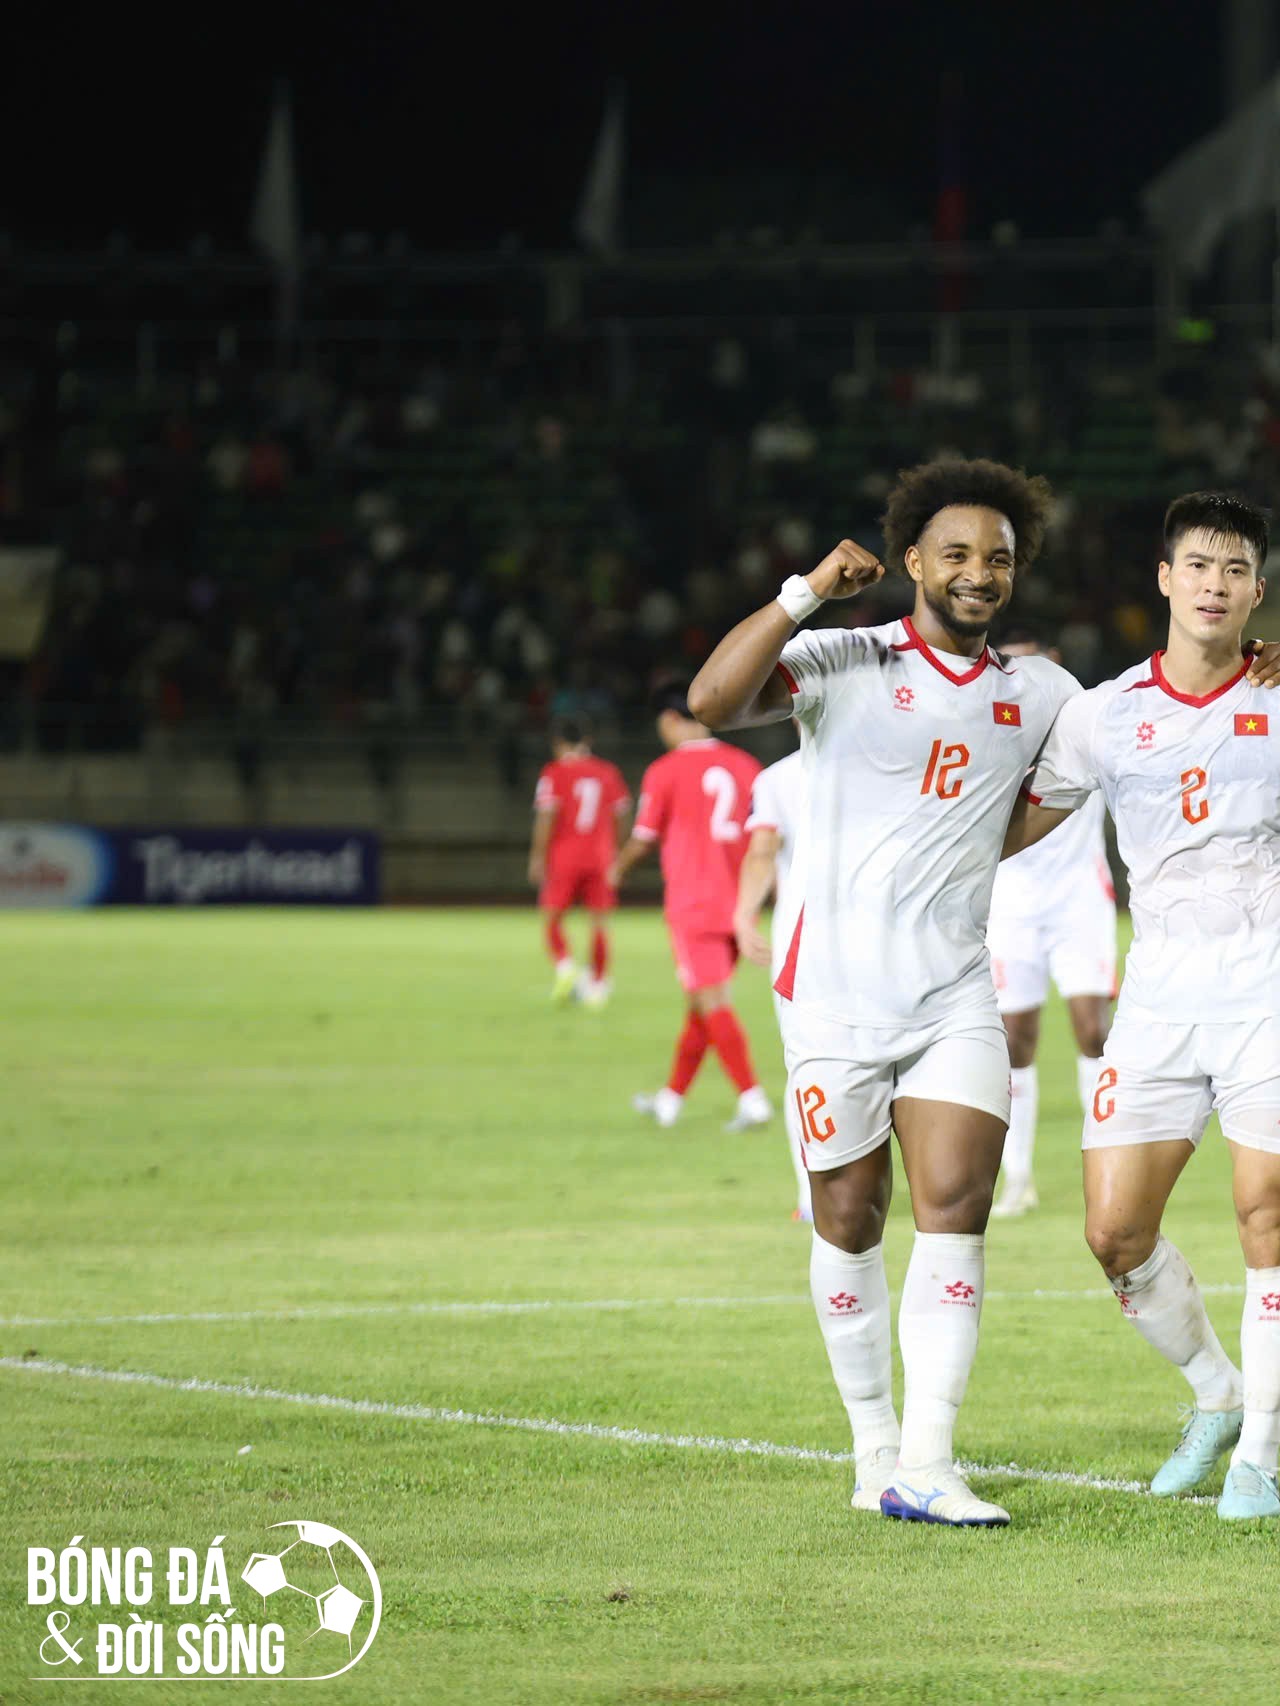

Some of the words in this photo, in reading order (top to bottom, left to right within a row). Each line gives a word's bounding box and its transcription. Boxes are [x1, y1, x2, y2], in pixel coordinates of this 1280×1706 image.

[920, 739, 970, 800] 12
[1180, 766, 1209, 825] 2
[702, 766, 742, 842] 2
[796, 1084, 836, 1143] 12
[1093, 1067, 1117, 1122] 2
